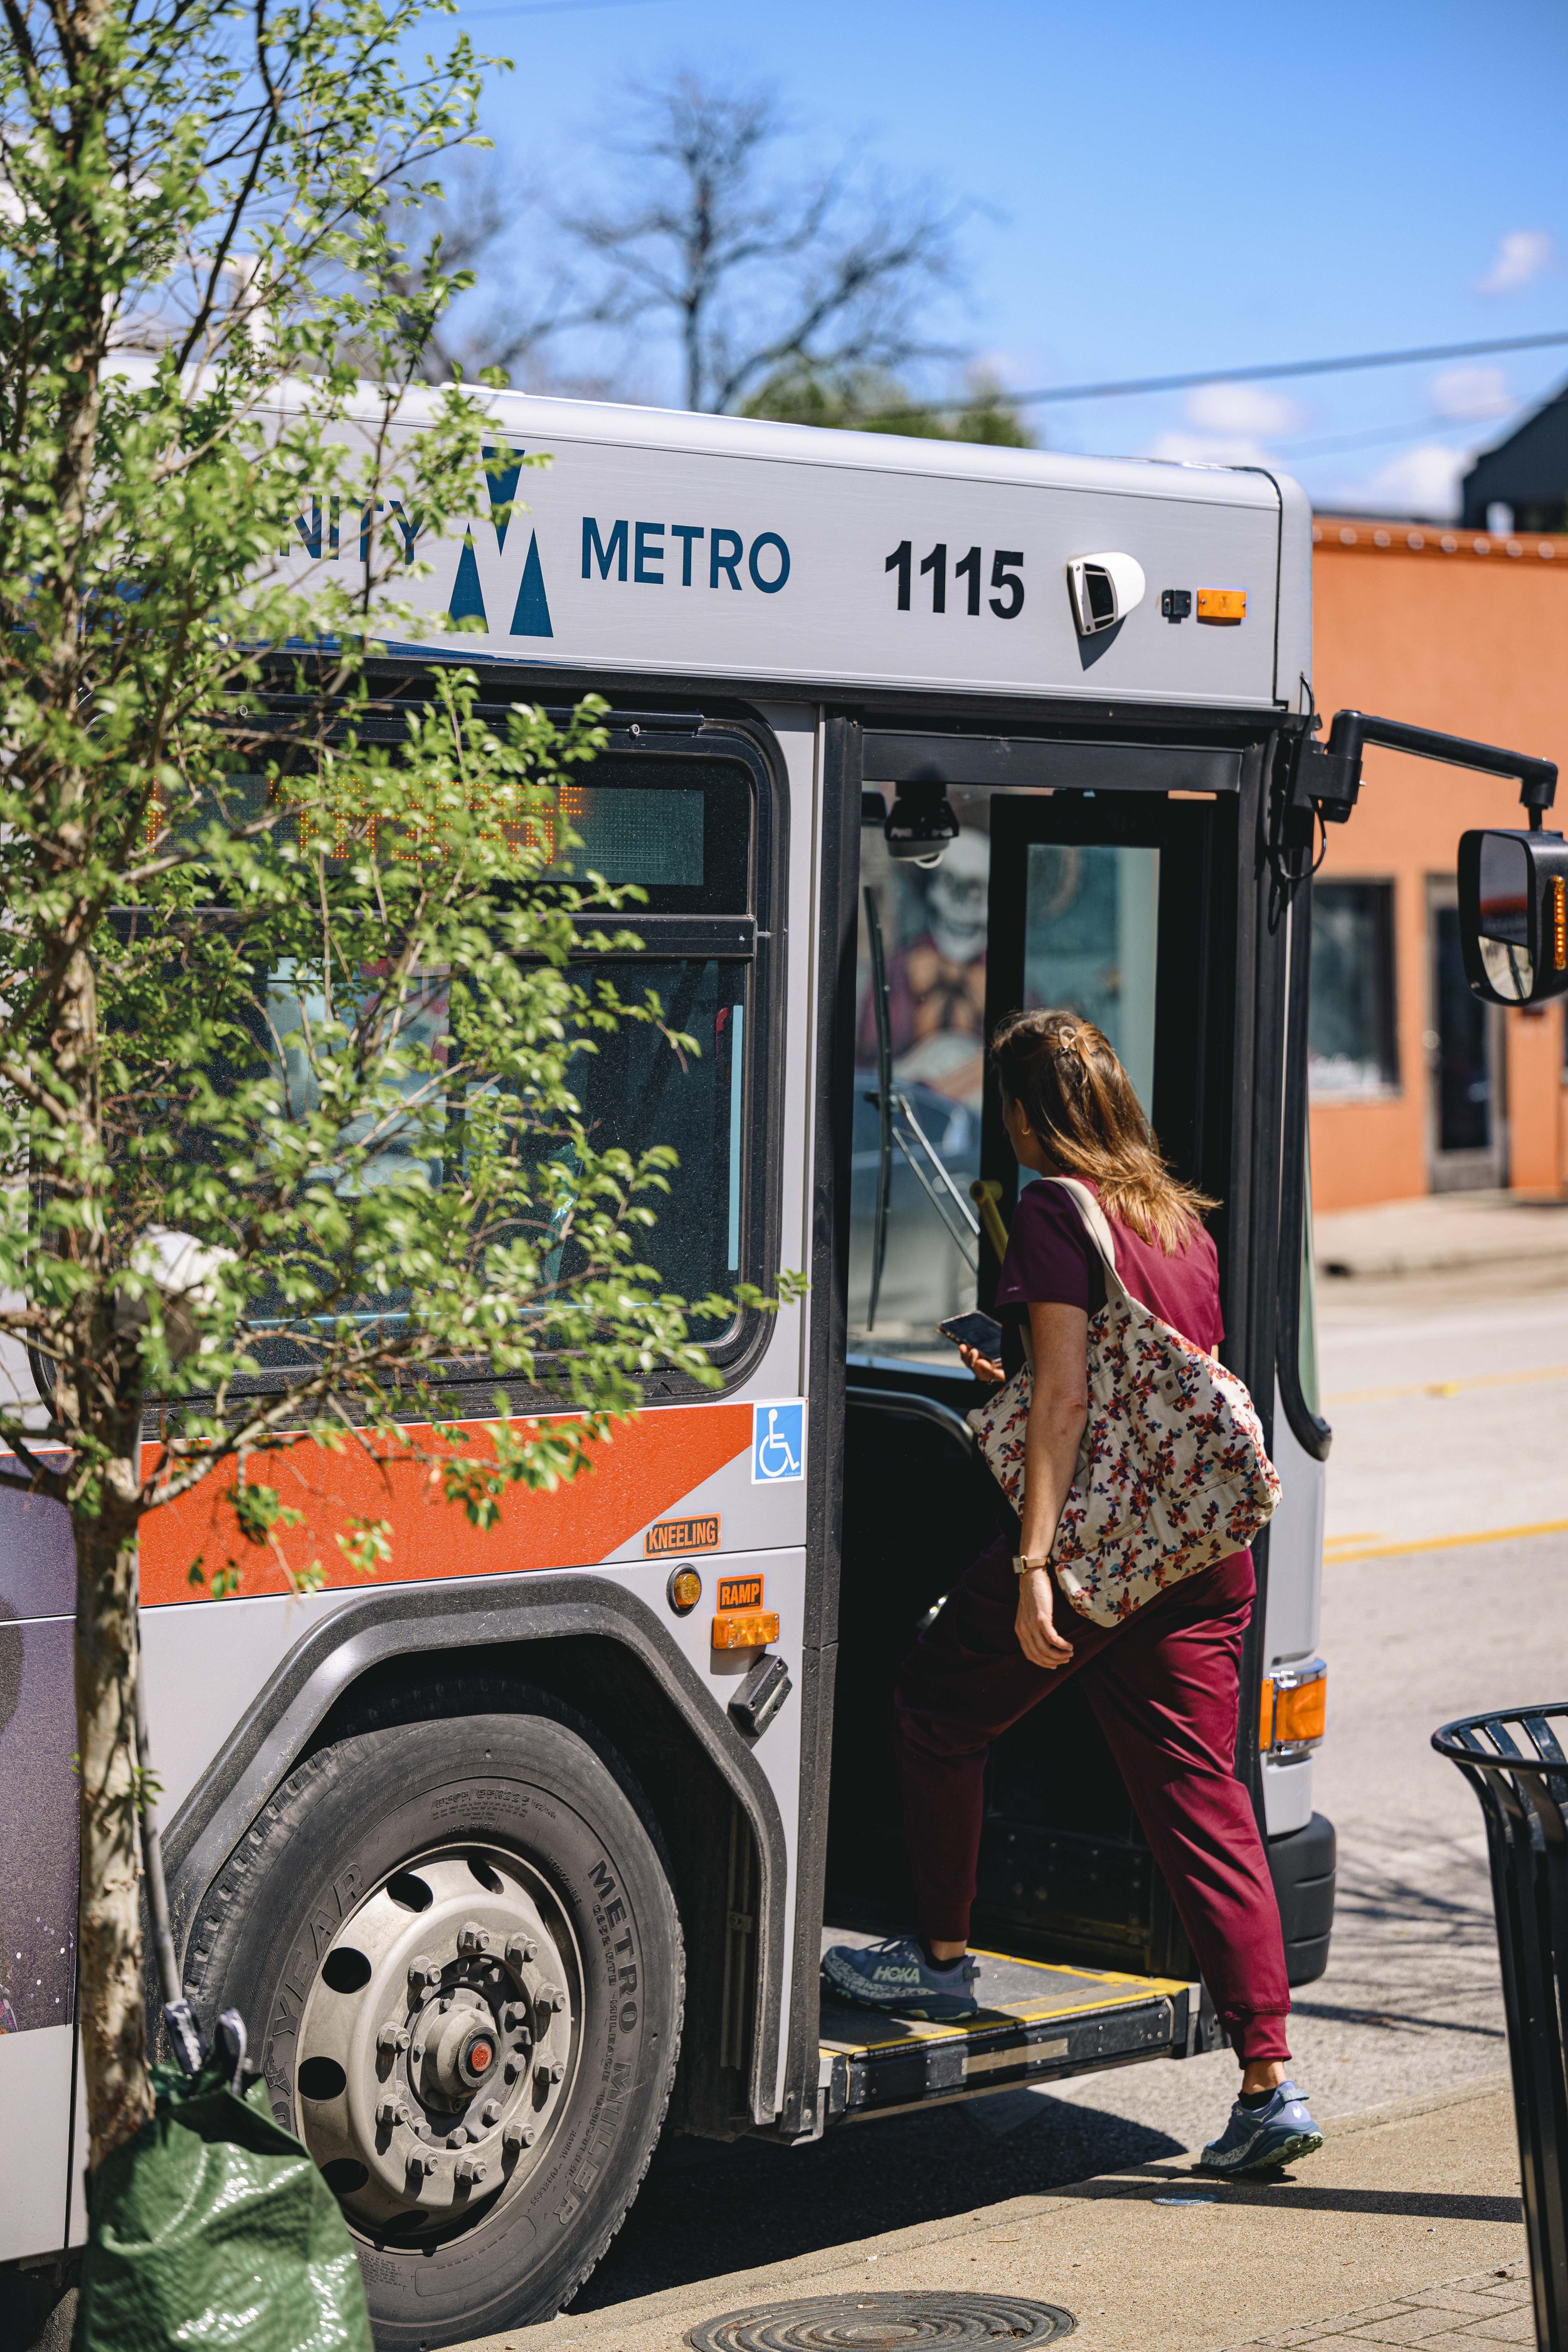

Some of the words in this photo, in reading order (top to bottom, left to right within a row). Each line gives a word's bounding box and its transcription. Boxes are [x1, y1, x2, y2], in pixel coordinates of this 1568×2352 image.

[581, 516, 791, 594] METRO
[884, 540, 1025, 620] 1115
[649, 1520, 716, 1550] KNEELING
[721, 1582, 760, 1606] RAMP
[546, 1857, 582, 1904] REGROOVABLE
[588, 1858, 638, 2033] METRO
[593, 1904, 610, 1947] G652
[605, 1951, 617, 1986] RTB
[872, 1966, 921, 1984] HOKA
[601, 1998, 618, 2082] MILEAGE
[553, 2062, 632, 2225] MILER
[559, 2130, 577, 2159] RADIAL
[565, 2092, 605, 2180] UNISTEEL
[531, 2168, 560, 2207] TUBELESS
